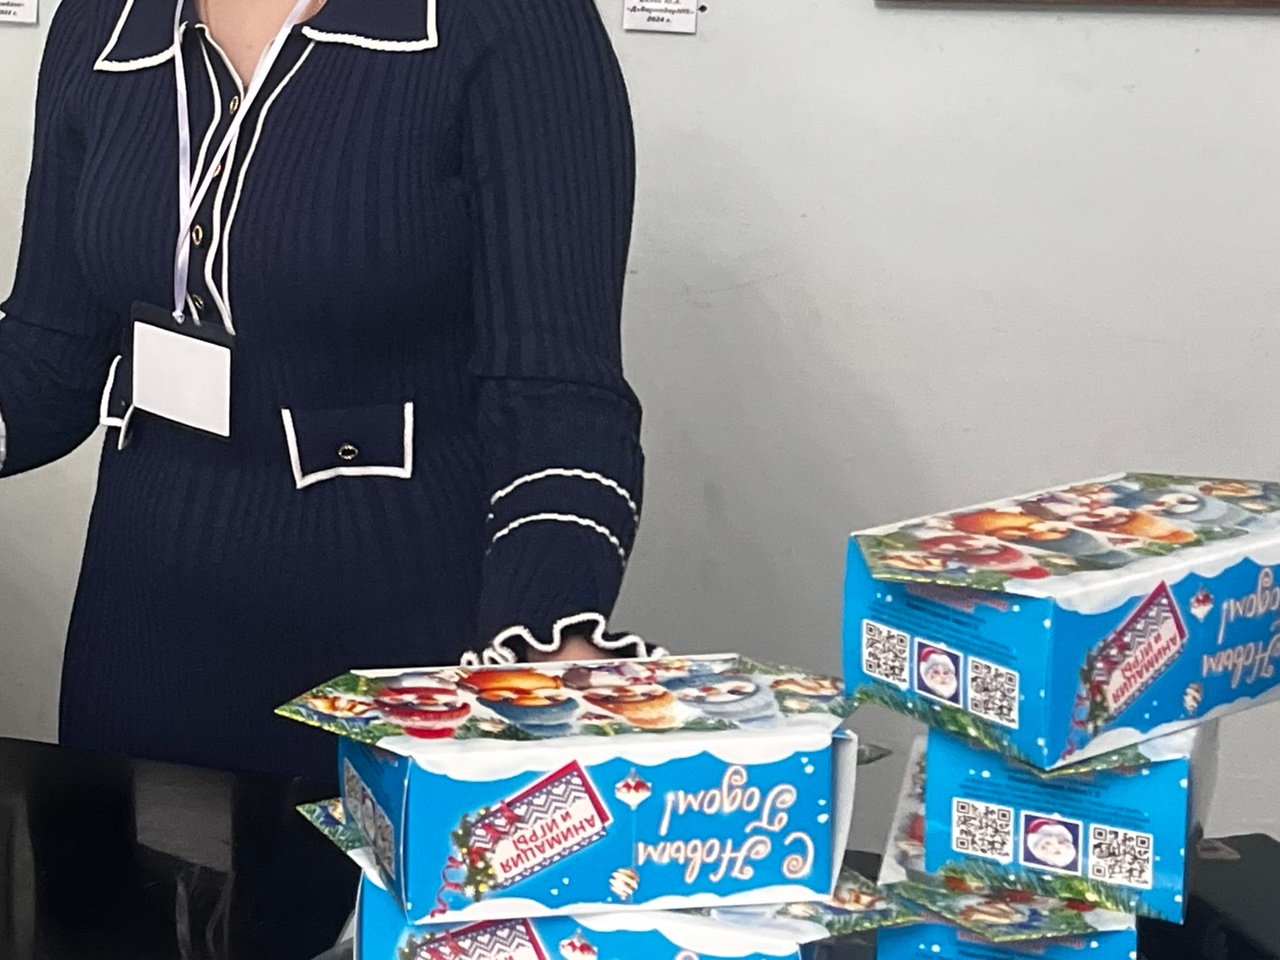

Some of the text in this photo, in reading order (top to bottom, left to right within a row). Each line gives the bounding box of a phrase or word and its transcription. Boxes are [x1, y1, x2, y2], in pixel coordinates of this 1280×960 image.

[1217, 567, 1280, 644] одом!
[1112, 634, 1179, 704] АНИМАЦИЯ
[1121, 643, 1153, 678] ИГРЫ
[658, 764, 798, 836] Годом!
[500, 814, 596, 874] АНИМАЦИЯ
[512, 818, 560, 851] ИГРЫ
[637, 831, 815, 884] С Новым
